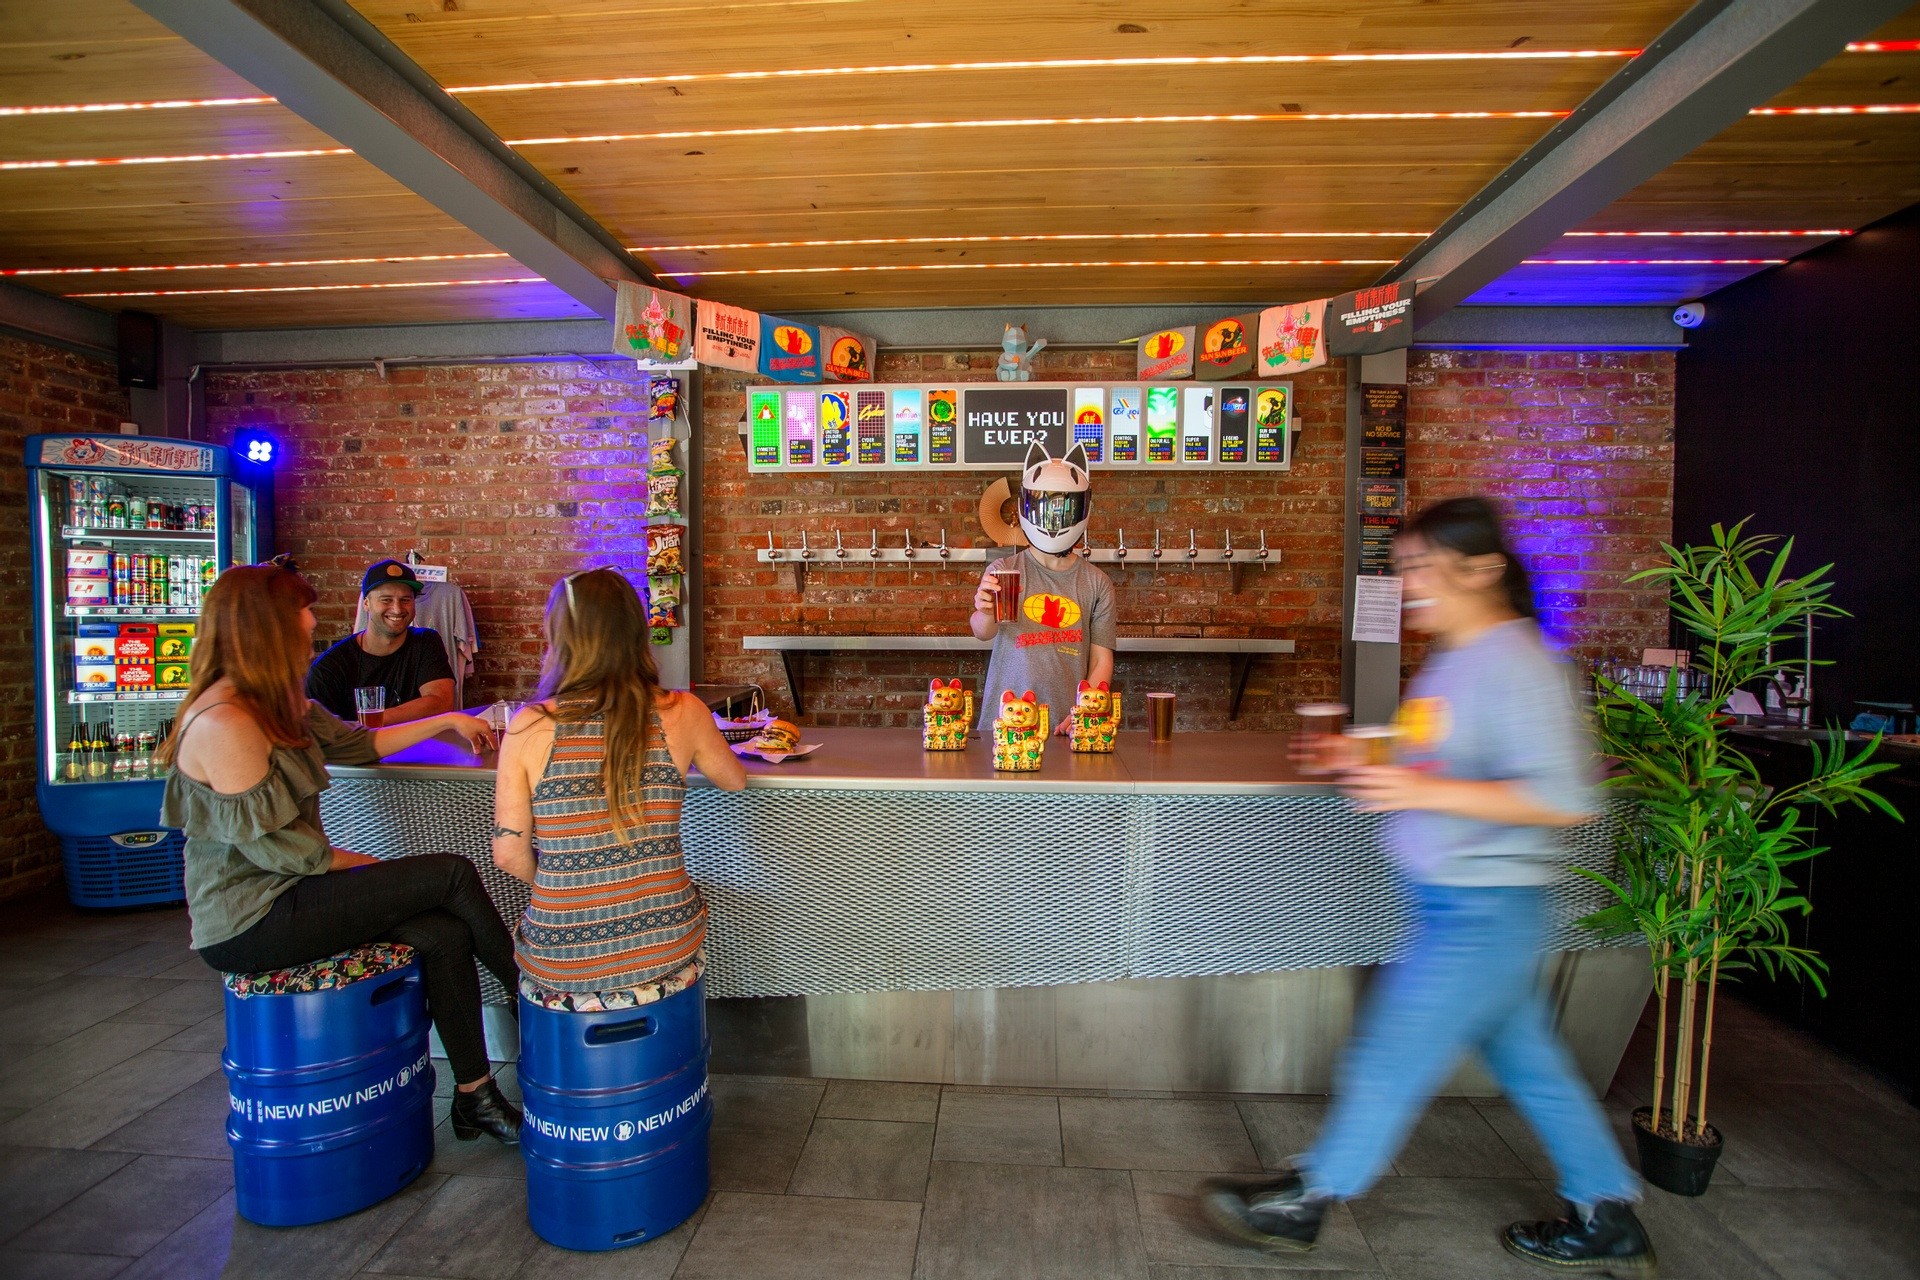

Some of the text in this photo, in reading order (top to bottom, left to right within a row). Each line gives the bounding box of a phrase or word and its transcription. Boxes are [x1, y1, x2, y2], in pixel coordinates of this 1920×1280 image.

[1355, 283, 1400, 310] 新新新
[1341, 298, 1411, 321] FILLING YOUR
[1346, 307, 1406, 326] EMPTINESS
[715, 311, 748, 337] 新新新
[702, 327, 756, 346] FILLING YOUR
[706, 334, 753, 351] EMPTINESS
[1200, 346, 1248, 362] SUN SUN BEER
[1262, 341, 1285, 361] 先生
[826, 364, 870, 379] SUN SUN BEER
[1222, 402, 1248, 411] Legend
[968, 412, 1064, 426] HAVE YOU
[984, 430, 1048, 445] EVER?
[118, 441, 199, 469] 新新新
[648, 536, 680, 556] Juan
[1016, 630, 1083, 640] NEW NEW NEW
[1016, 636, 1083, 649] CORPORATION
[264, 1104, 304, 1120] NEW
[308, 1094, 352, 1116] NEW
[356, 1077, 394, 1104] NEW
[412, 1053, 429, 1077] NEW
[538, 1118, 566, 1140] NEW
[570, 1126, 609, 1141] NEW
[638, 1108, 674, 1134] NEW
[676, 1090, 700, 1118] NEW
[700, 1076, 710, 1100] NE
